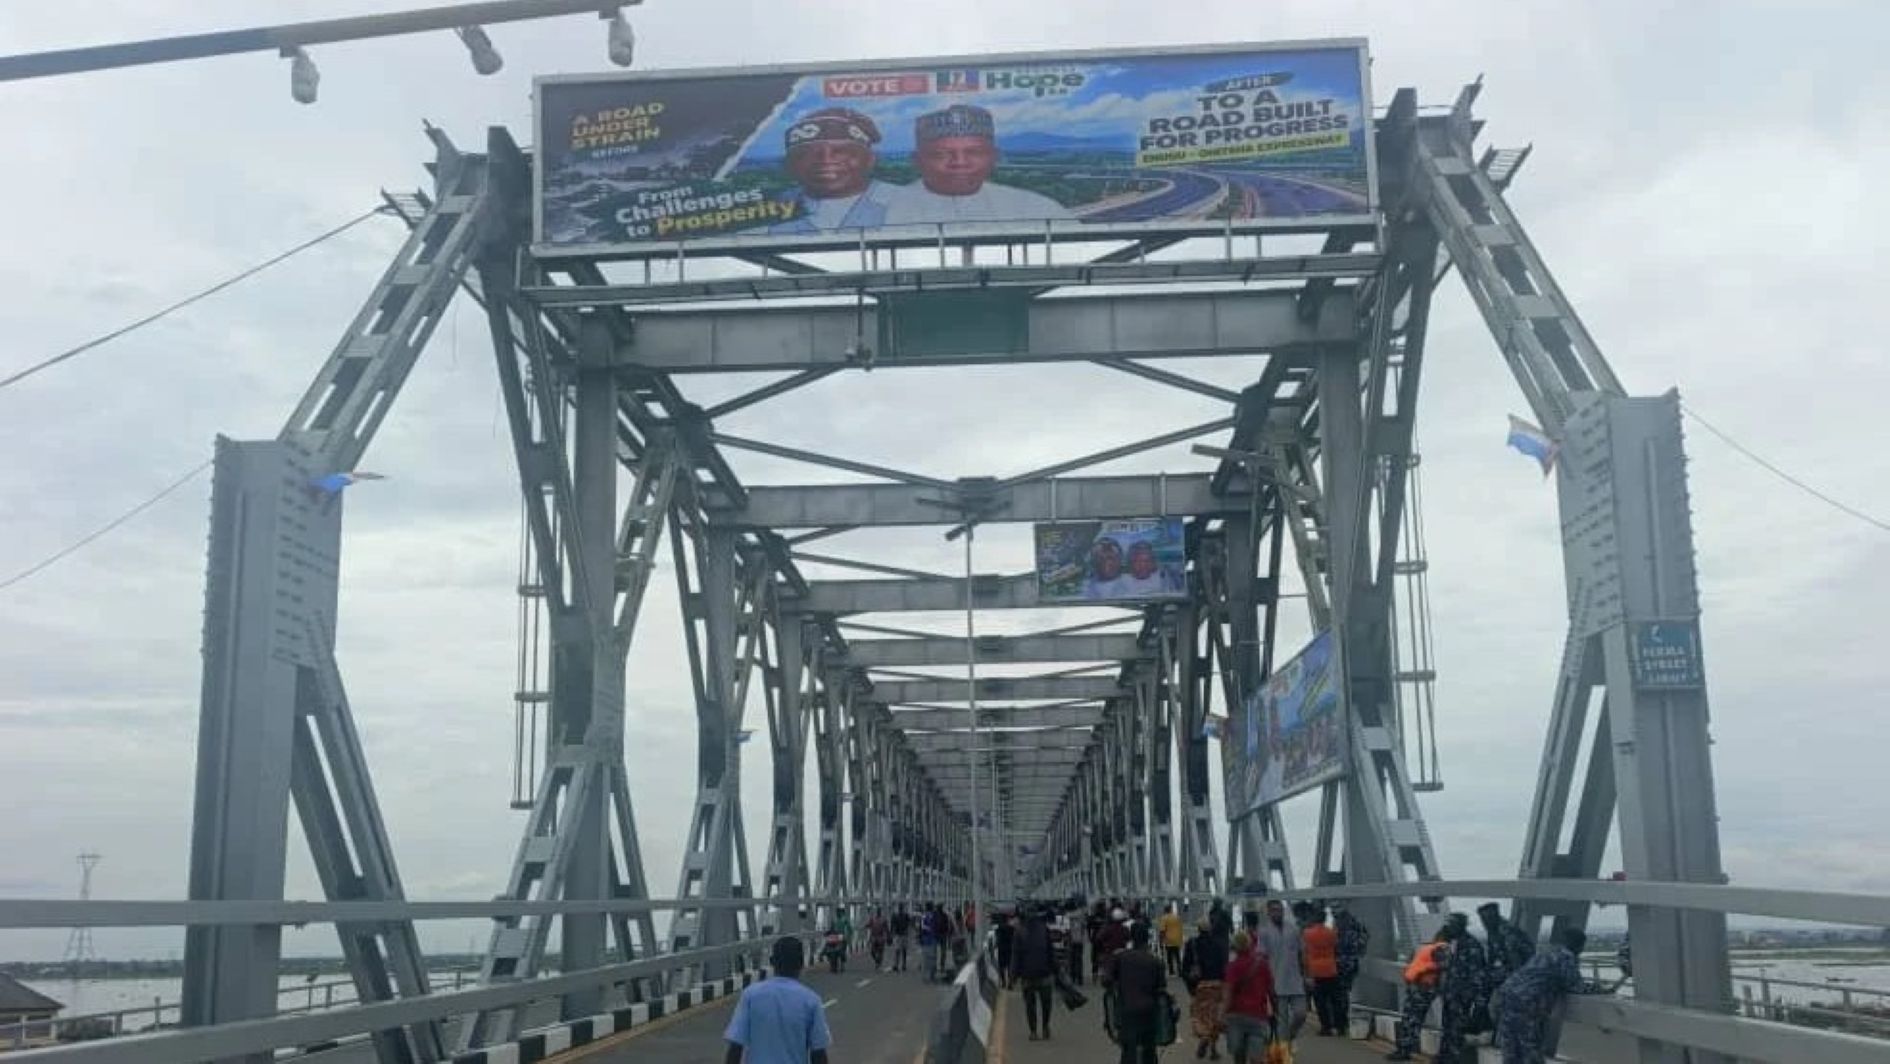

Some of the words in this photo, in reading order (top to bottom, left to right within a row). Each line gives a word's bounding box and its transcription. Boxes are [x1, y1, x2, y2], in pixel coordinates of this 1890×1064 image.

[829, 79, 898, 95] VOTE
[986, 71, 1085, 97] Hope
[1197, 93, 1244, 111] TO
[1253, 89, 1279, 105] A
[572, 114, 590, 126] A
[598, 102, 664, 121] ROAD
[1150, 111, 1245, 133] ROAD
[1253, 99, 1333, 123] BUILT
[571, 127, 660, 149] STRAIN
[573, 118, 649, 137] UNDER
[1140, 132, 1198, 150] FOR
[1204, 114, 1348, 144] PROGRESS
[615, 188, 763, 223] Challenges
[638, 186, 692, 204] From
[626, 224, 650, 238] to
[655, 201, 796, 236] Prosperity
